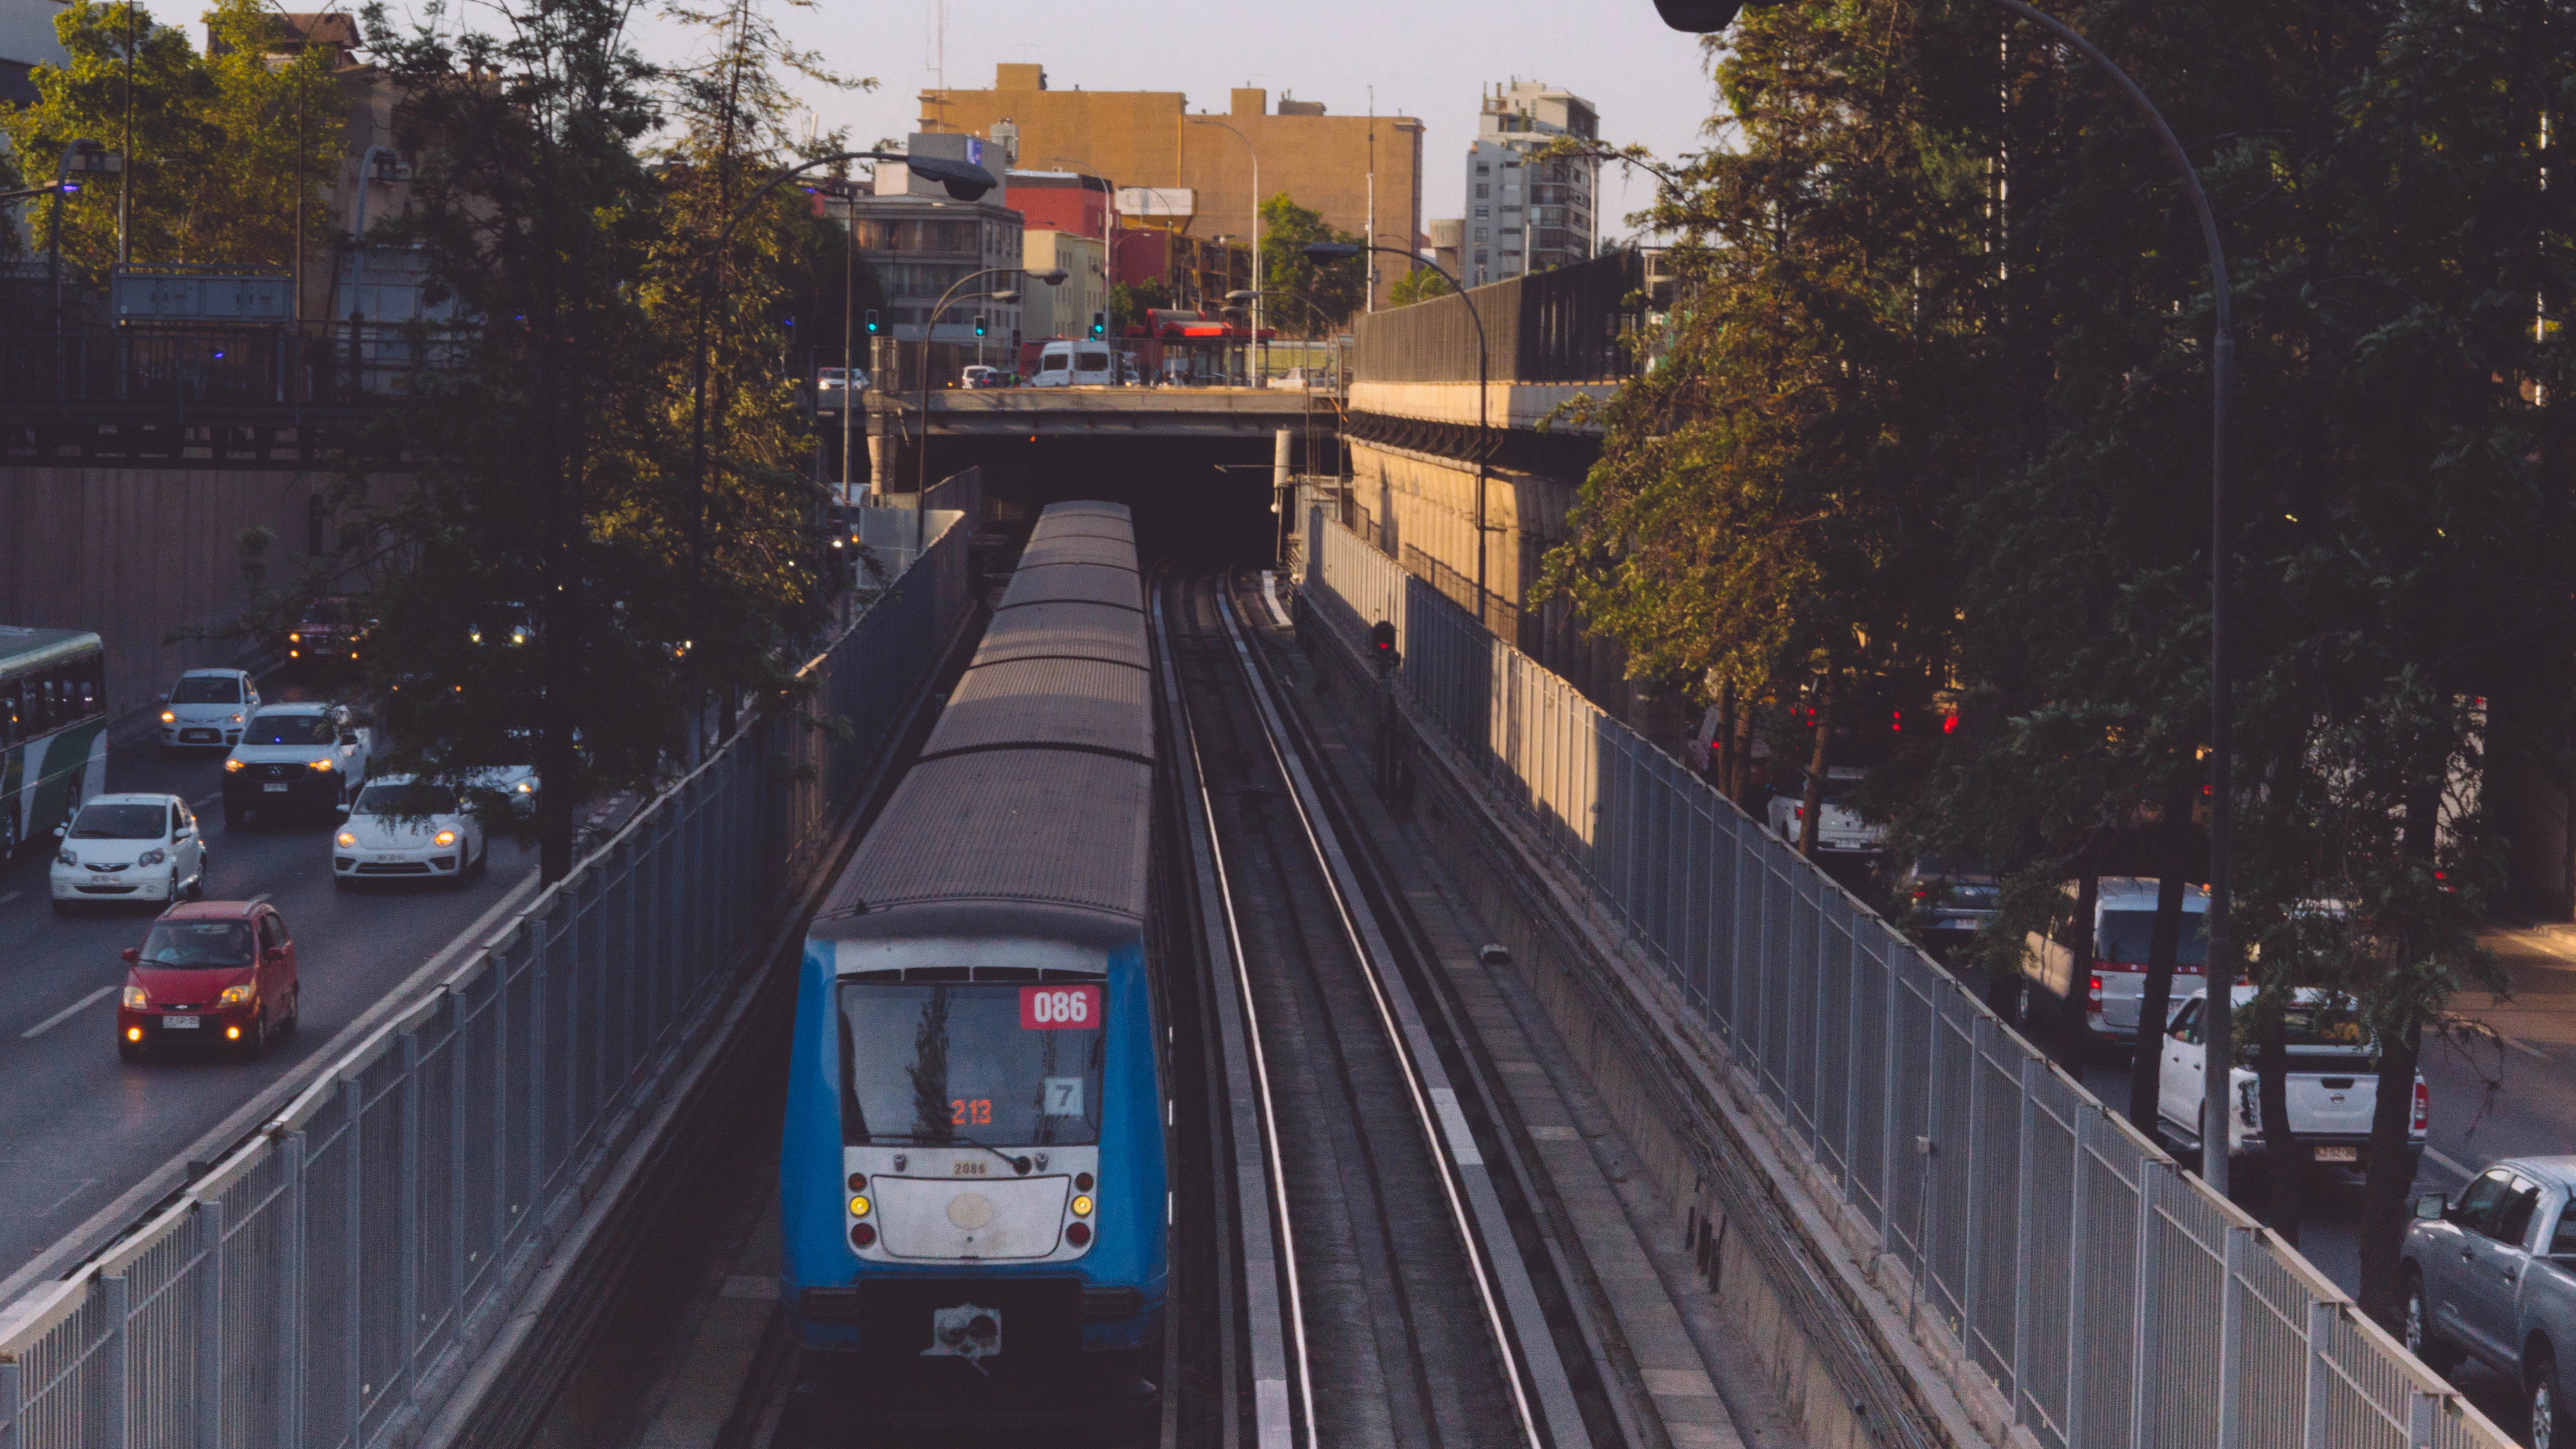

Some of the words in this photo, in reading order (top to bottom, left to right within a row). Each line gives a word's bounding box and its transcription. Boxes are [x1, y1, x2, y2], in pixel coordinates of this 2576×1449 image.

[1034, 992, 1087, 1022] 086
[1056, 1084, 1073, 1107] 7
[951, 1099, 991, 1124] 213
